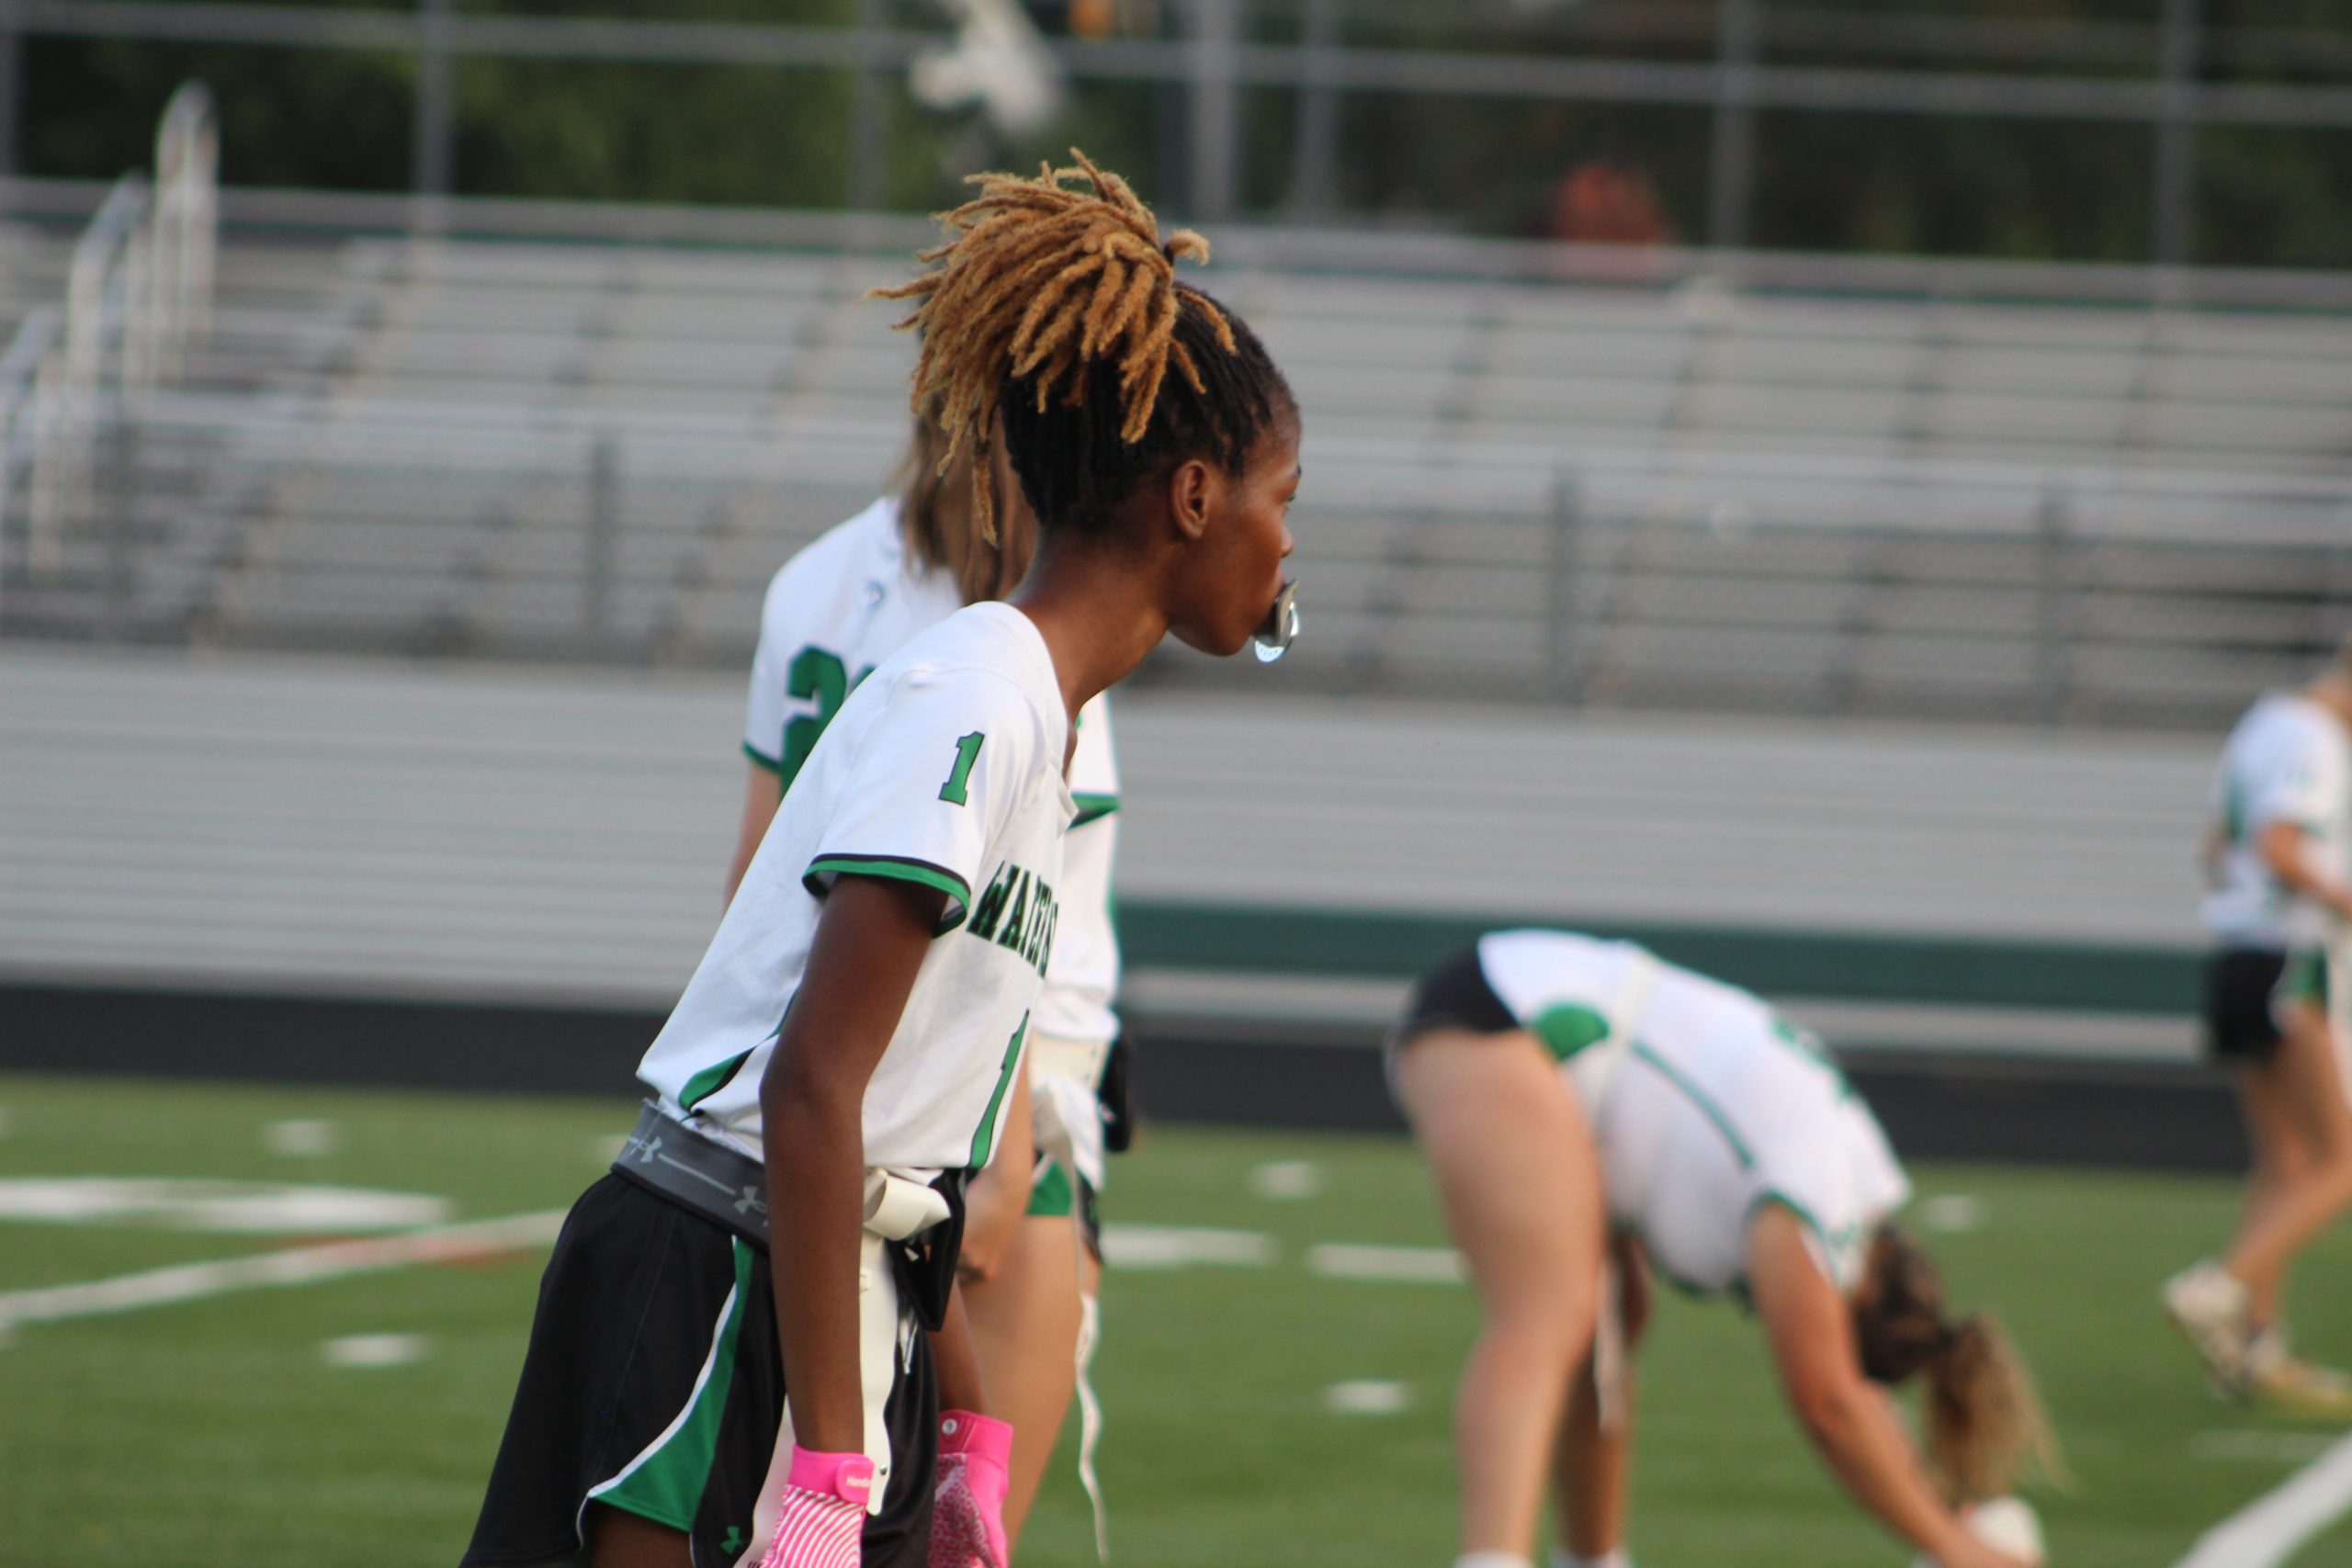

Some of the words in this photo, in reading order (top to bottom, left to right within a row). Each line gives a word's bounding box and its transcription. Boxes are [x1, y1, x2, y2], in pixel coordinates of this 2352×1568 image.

[780, 644, 876, 803] 2
[938, 731, 985, 807] 1
[967, 1008, 1030, 1168] 1
